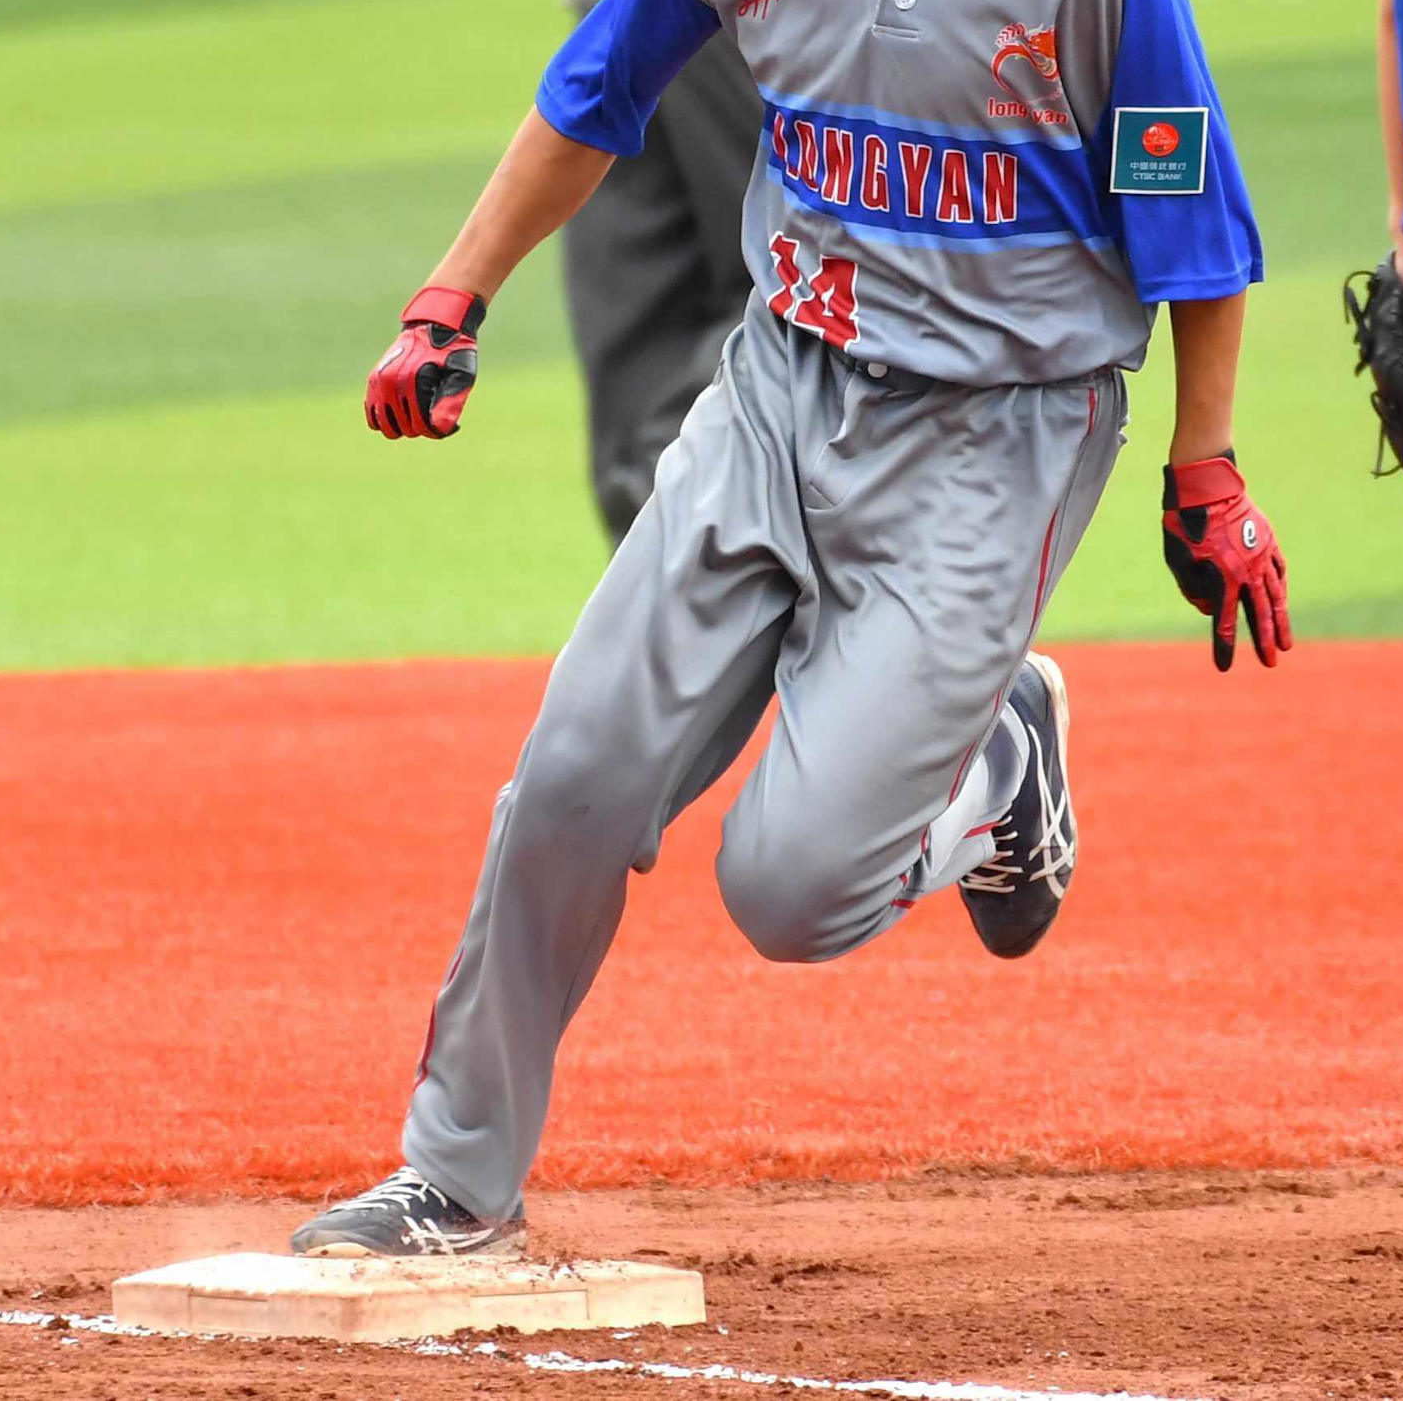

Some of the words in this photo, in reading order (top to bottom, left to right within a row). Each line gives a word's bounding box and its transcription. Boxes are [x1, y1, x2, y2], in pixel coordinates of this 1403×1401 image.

[987, 97, 1028, 117] long
[1031, 108, 1069, 124] yan
[772, 110, 1018, 224] LONGYAN
[1132, 172, 1156, 181] CTBC
[1157, 172, 1182, 181] BANK
[766, 230, 862, 353] 14
